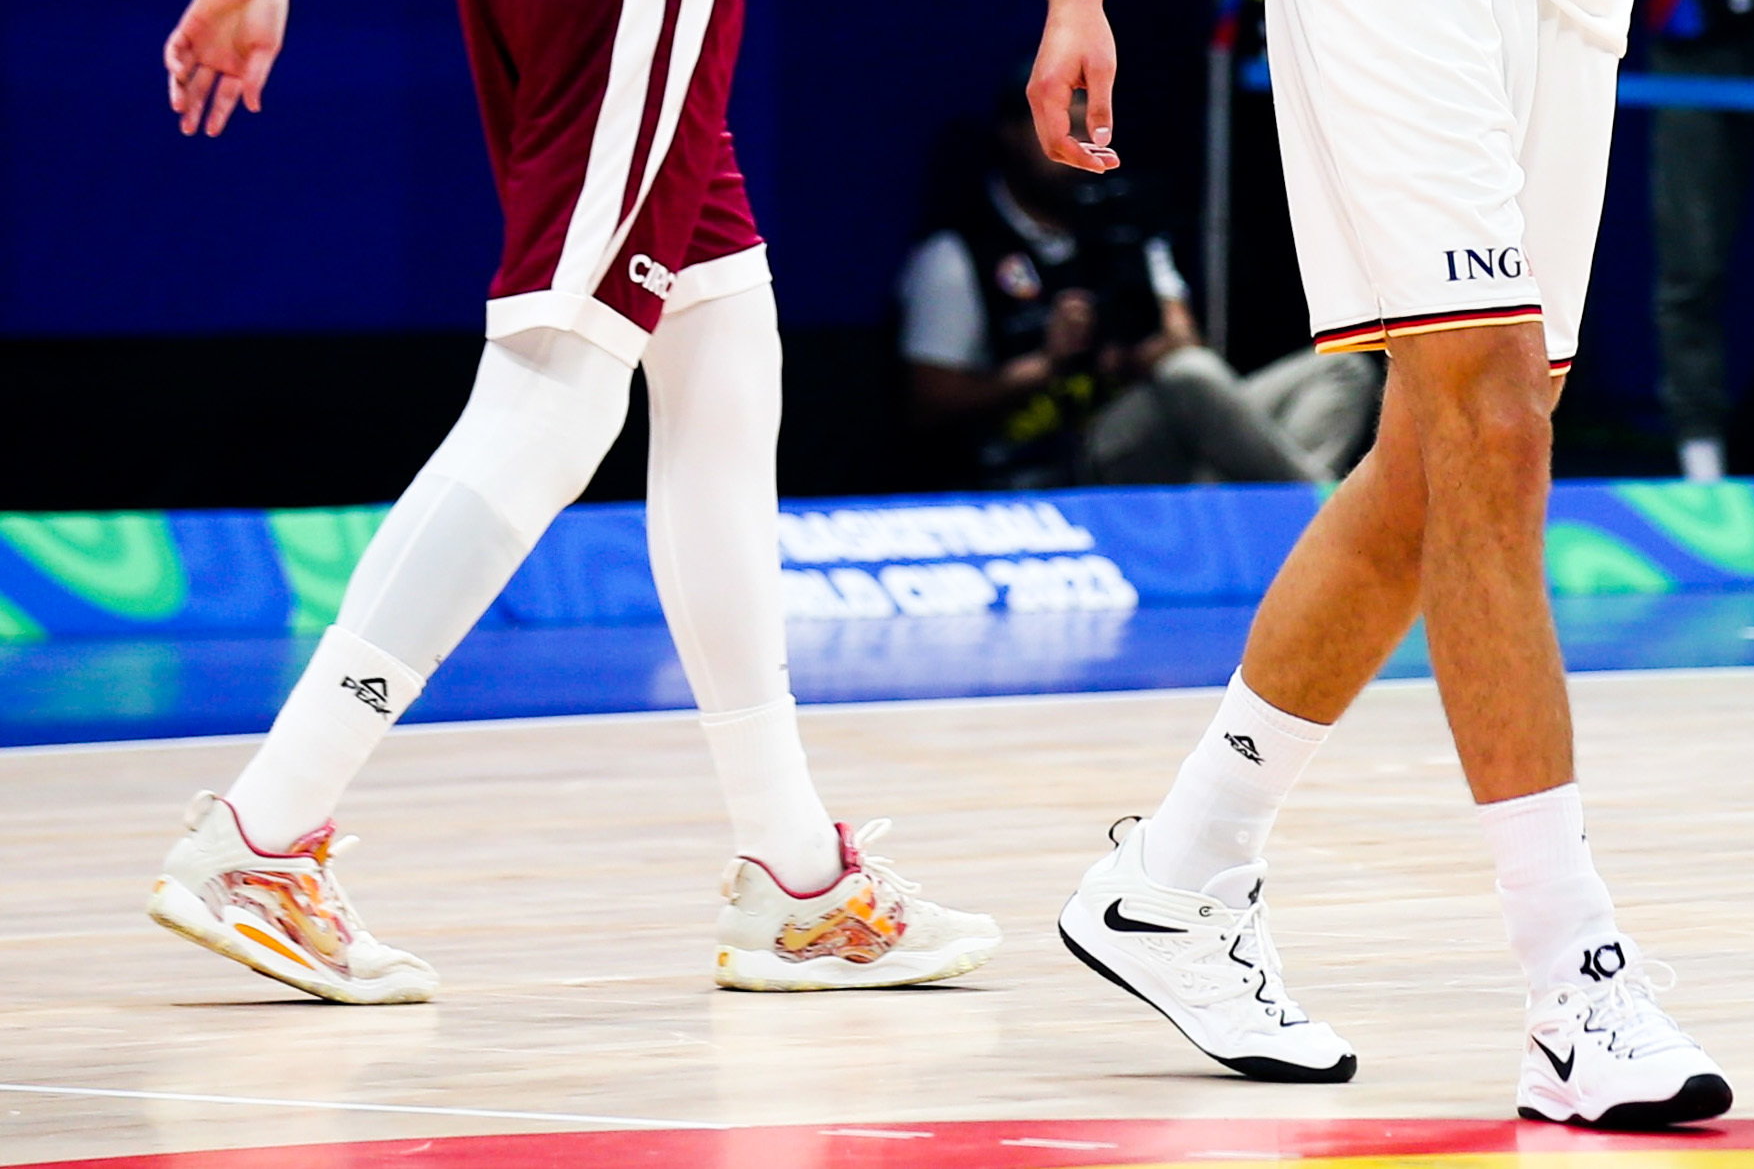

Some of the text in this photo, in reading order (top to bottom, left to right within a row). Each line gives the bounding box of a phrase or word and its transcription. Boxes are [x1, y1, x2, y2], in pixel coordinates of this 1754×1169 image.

[1443, 247, 1523, 282] ING
[879, 562, 999, 616] CUP
[985, 554, 1140, 614] 2023
[340, 676, 393, 721] PEAK
[1223, 731, 1266, 767] PEAK
